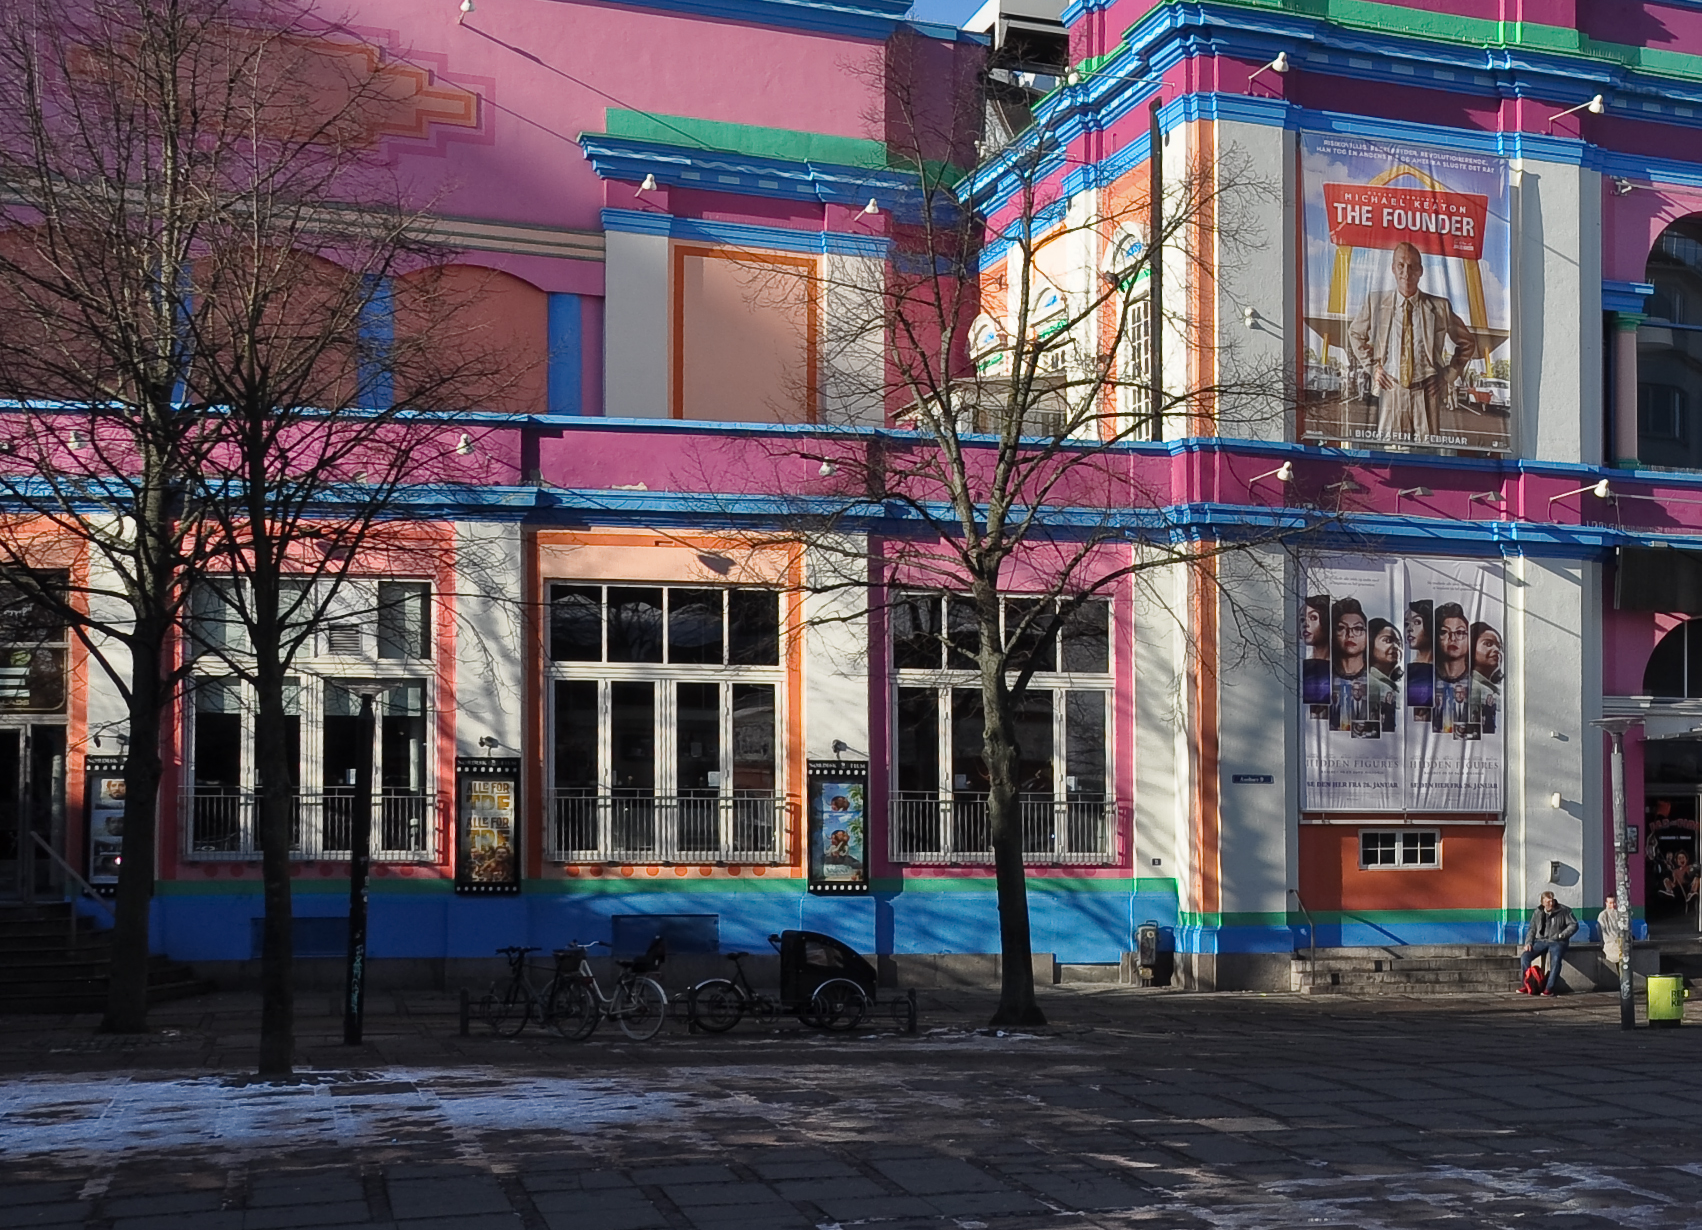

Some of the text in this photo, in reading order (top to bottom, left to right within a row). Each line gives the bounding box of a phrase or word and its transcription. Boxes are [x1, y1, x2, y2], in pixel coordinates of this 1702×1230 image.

[1316, 146, 1331, 154] HAN
[1344, 192, 1467, 214] MICHAEL KEATON
[1333, 202, 1475, 237] THE FOUNDER
[1355, 429, 1411, 441] BIOGRAFEN
[1424, 434, 1468, 445] FEBRUAR
[1306, 759, 1399, 768] HIDDEN FIGURES
[1409, 760, 1499, 770] HIDDEN FIGURES
[491, 782, 510, 794] FOR
[1372, 781, 1399, 789] JANUAR
[490, 816, 510, 829] FOR
